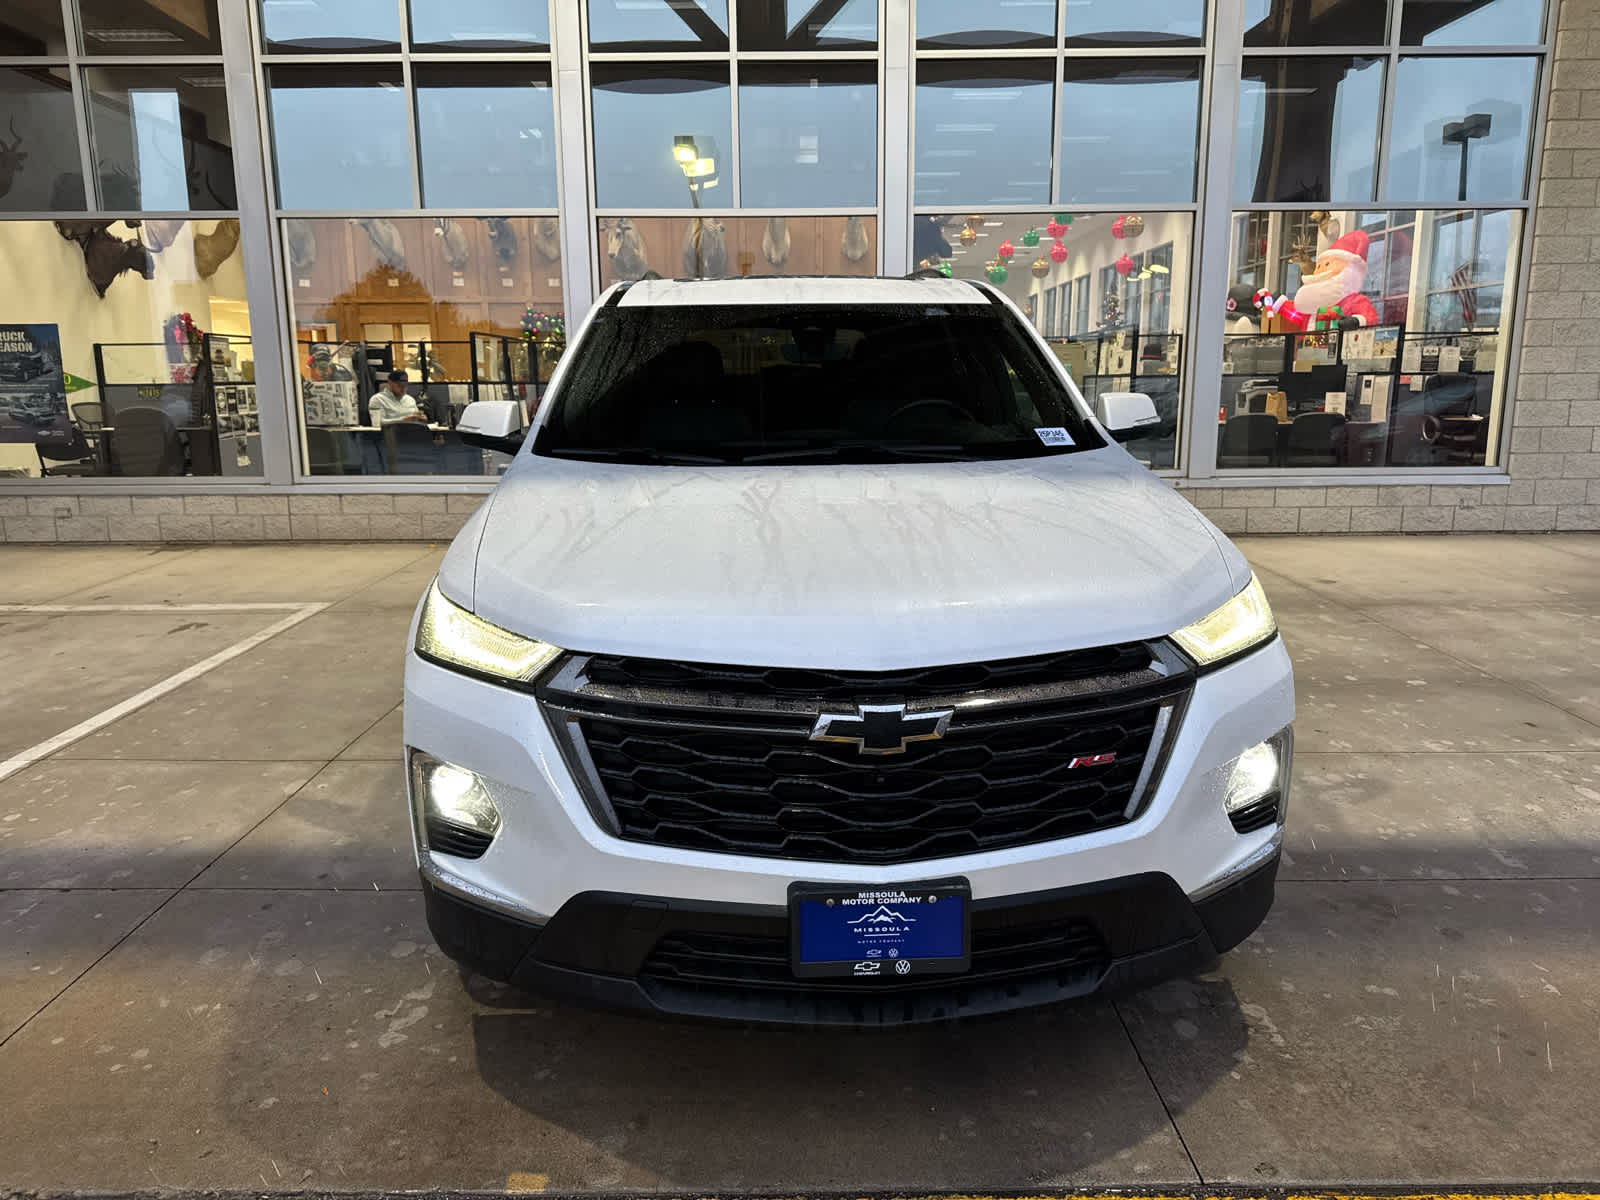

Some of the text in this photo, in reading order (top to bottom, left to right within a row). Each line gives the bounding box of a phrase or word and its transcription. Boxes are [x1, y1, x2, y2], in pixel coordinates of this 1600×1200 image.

[1067, 752, 1116, 768] RS
[858, 891, 906, 899] MISSOULA
[877, 896, 922, 904] COMPANY
